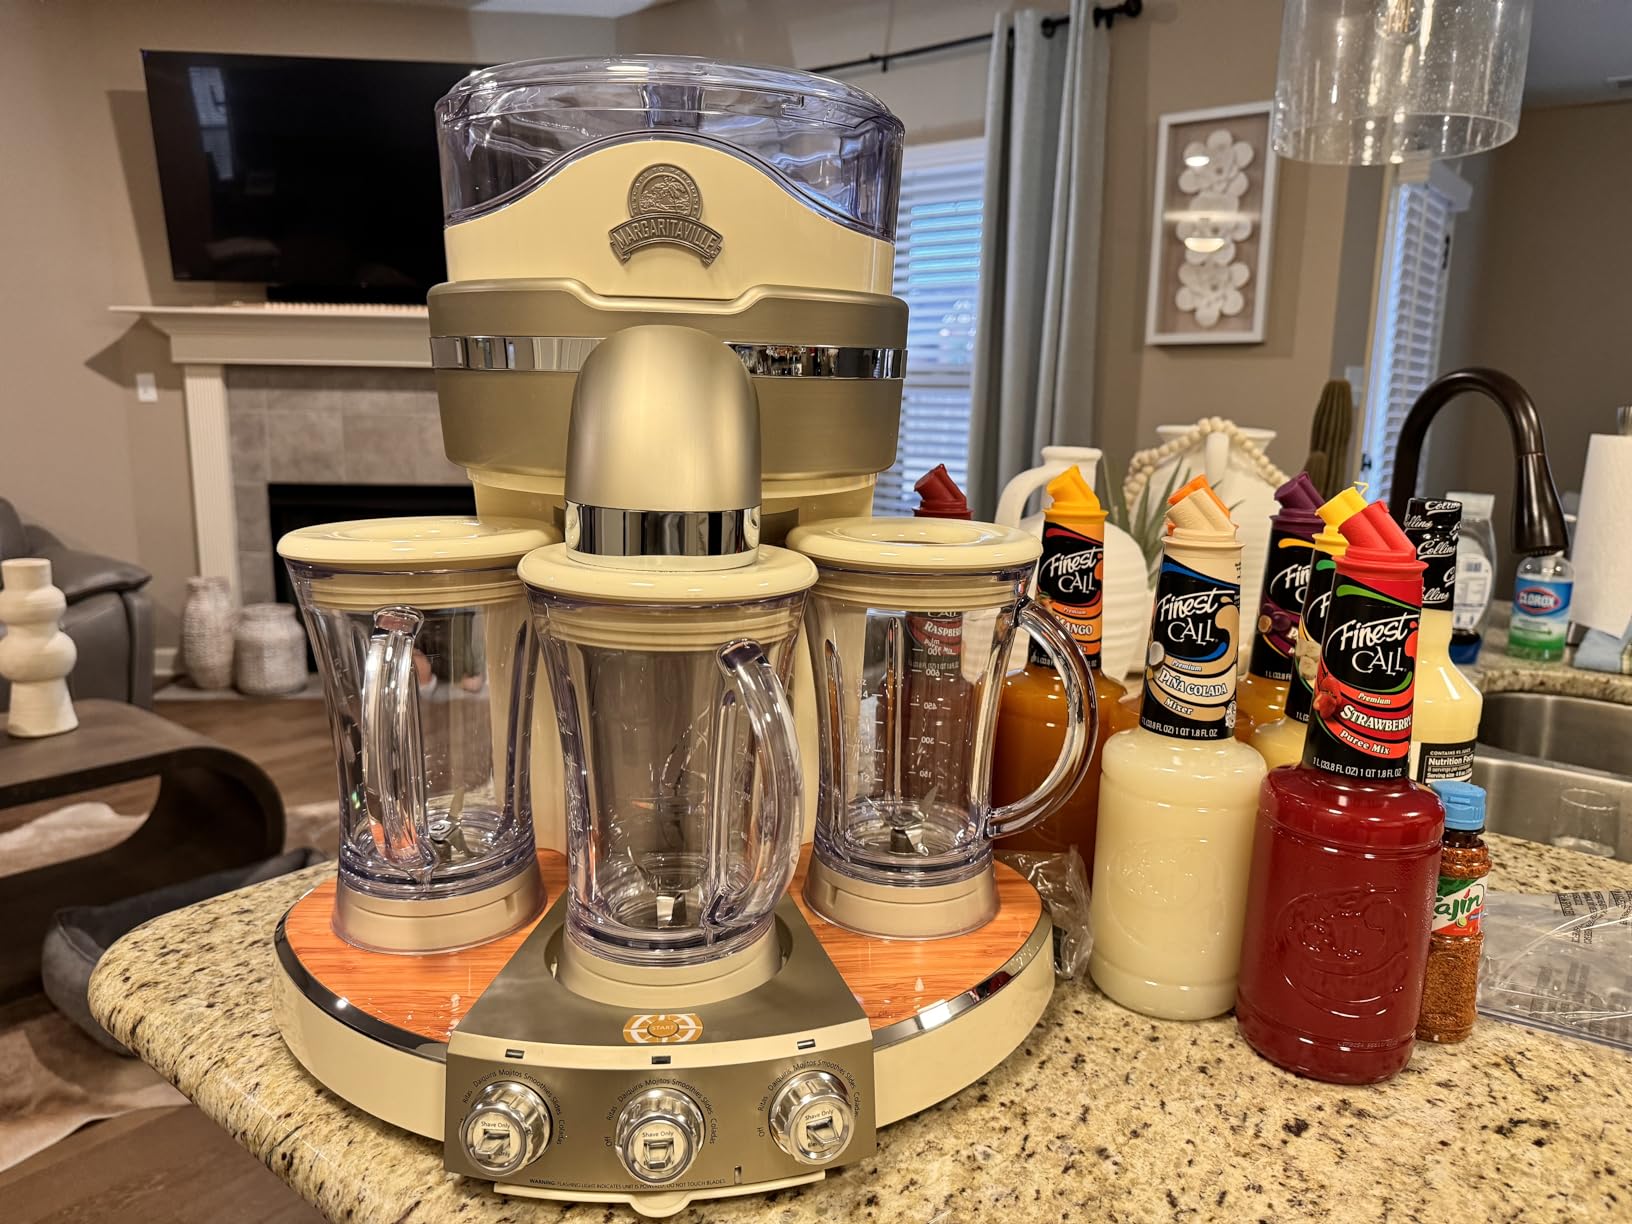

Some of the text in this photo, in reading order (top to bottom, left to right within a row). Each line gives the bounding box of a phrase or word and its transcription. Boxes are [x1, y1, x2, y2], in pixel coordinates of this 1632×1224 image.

[612, 218, 719, 252] MARGARITAVILLE
[1417, 540, 1456, 558] Collins
[1042, 547, 1103, 579] Finest
[1057, 572, 1095, 594] CALL
[1157, 588, 1230, 622] Finest
[1167, 618, 1214, 646] CALL
[1333, 612, 1415, 652] Finest
[1171, 660, 1202, 672] Premium
[1351, 646, 1404, 676] CALL
[1158, 669, 1228, 697] PIÑA COLADA
[1165, 698, 1193, 715] Mixer
[1358, 692, 1391, 705] Premium
[1156, 723, 1162, 732] FL
[1163, 724, 1174, 734] OZ)
[1180, 728, 1190, 736] QT
[1191, 729, 1200, 737] 1.8
[1201, 729, 1208, 737] FL
[1209, 729, 1218, 737] OZ
[1340, 704, 1411, 731] STRAWBERRY
[1340, 730, 1391, 755] Puree Mix
[1316, 758, 1320, 767] L
[1321, 760, 1335, 771] (33.8
[1336, 764, 1344, 774] FL
[1345, 766, 1358, 776] OZ)
[1360, 768, 1363, 777] 1
[1365, 769, 1376, 777] QT
[1377, 769, 1386, 778] 1.8
[1387, 769, 1394, 778] FL
[1395, 768, 1402, 776] OZ
[1428, 757, 1462, 766] Nutrition
[1432, 888, 1480, 921] ajín
[499, 1069, 522, 1078] Mojitos
[524, 1073, 552, 1098] Smoothies
[768, 1069, 792, 1092] Daiquiris
[792, 1060, 817, 1071] Mojitos
[817, 1059, 846, 1075] Smoothies
[607, 1106, 618, 1121] Ritas
[617, 1082, 643, 1103] Daiquiris
[645, 1078, 670, 1086] Mojitos
[672, 1079, 702, 1099] Smoothies
[701, 1097, 713, 1115] Slides
[709, 1118, 718, 1145] Coladas
[821, 1110, 834, 1118] Only
